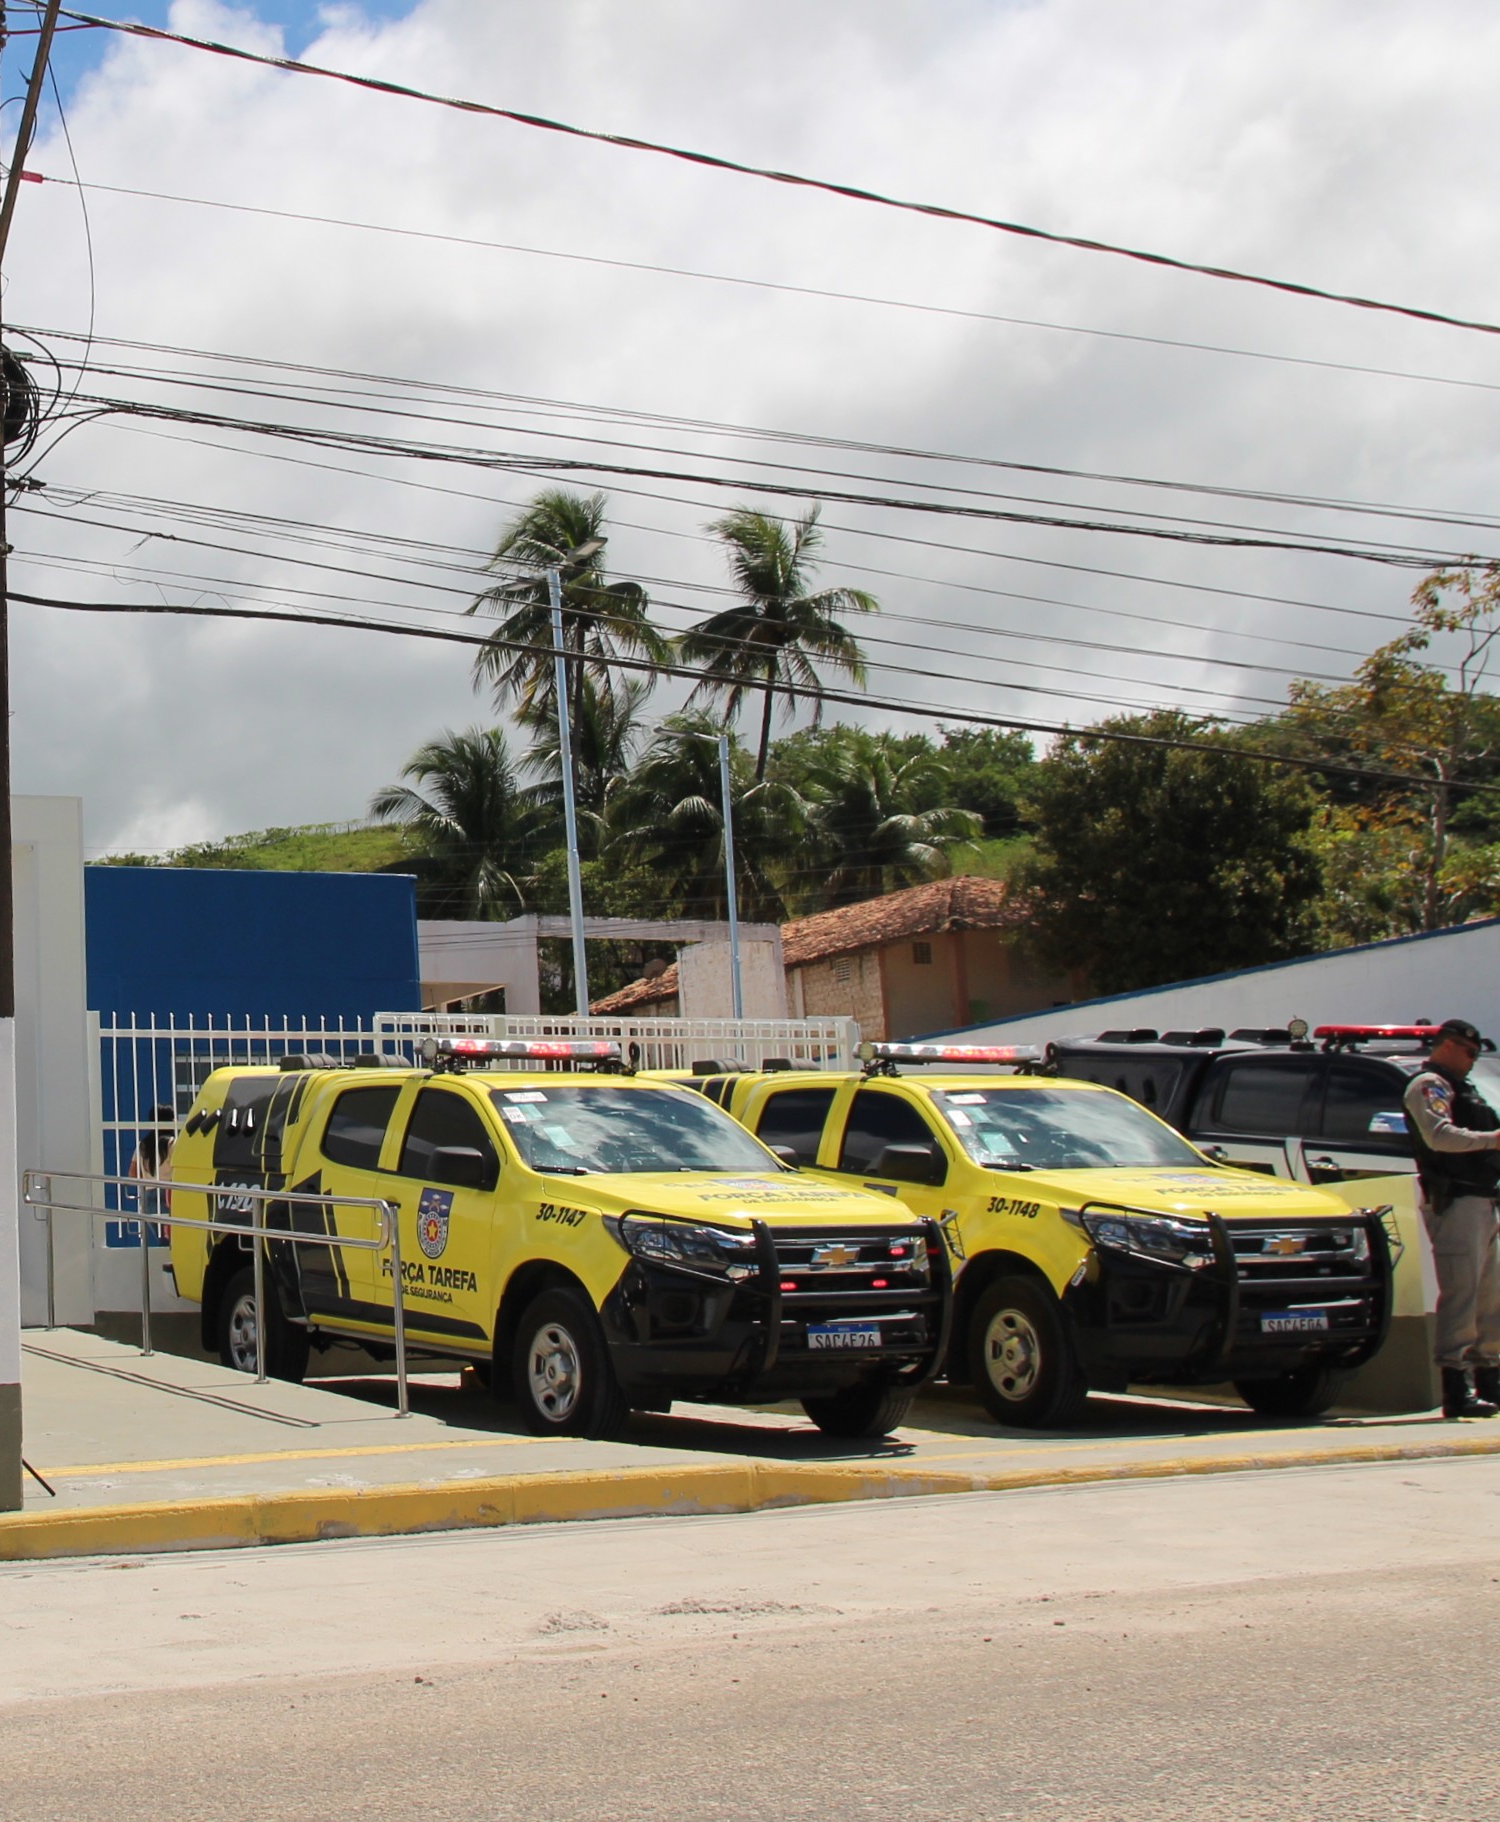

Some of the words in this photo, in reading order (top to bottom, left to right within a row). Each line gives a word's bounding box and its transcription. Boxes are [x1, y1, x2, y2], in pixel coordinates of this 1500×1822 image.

[536, 1202, 587, 1228] 30-1147
[987, 1196, 1041, 1218] 30-1148
[428, 1265, 478, 1292] TAREFA
[410, 1286, 453, 1303] SEGURANÇA
